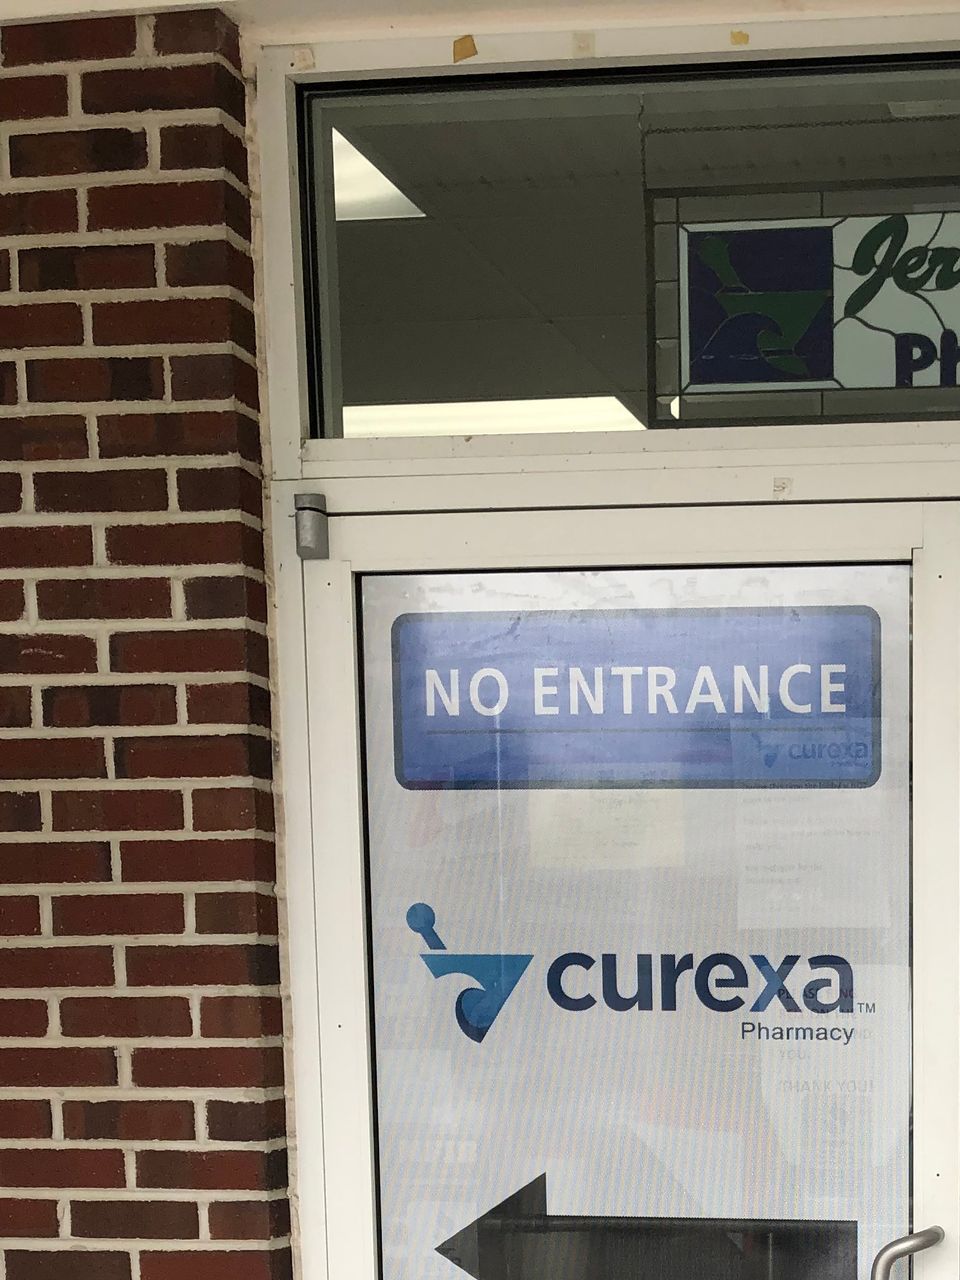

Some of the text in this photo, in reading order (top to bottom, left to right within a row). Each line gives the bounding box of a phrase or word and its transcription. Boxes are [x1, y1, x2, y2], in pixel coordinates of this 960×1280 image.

[426, 664, 846, 717] NO ENTRANCE
[547, 953, 854, 1013] curexa
[741, 1022, 854, 1045] Pharmacy
